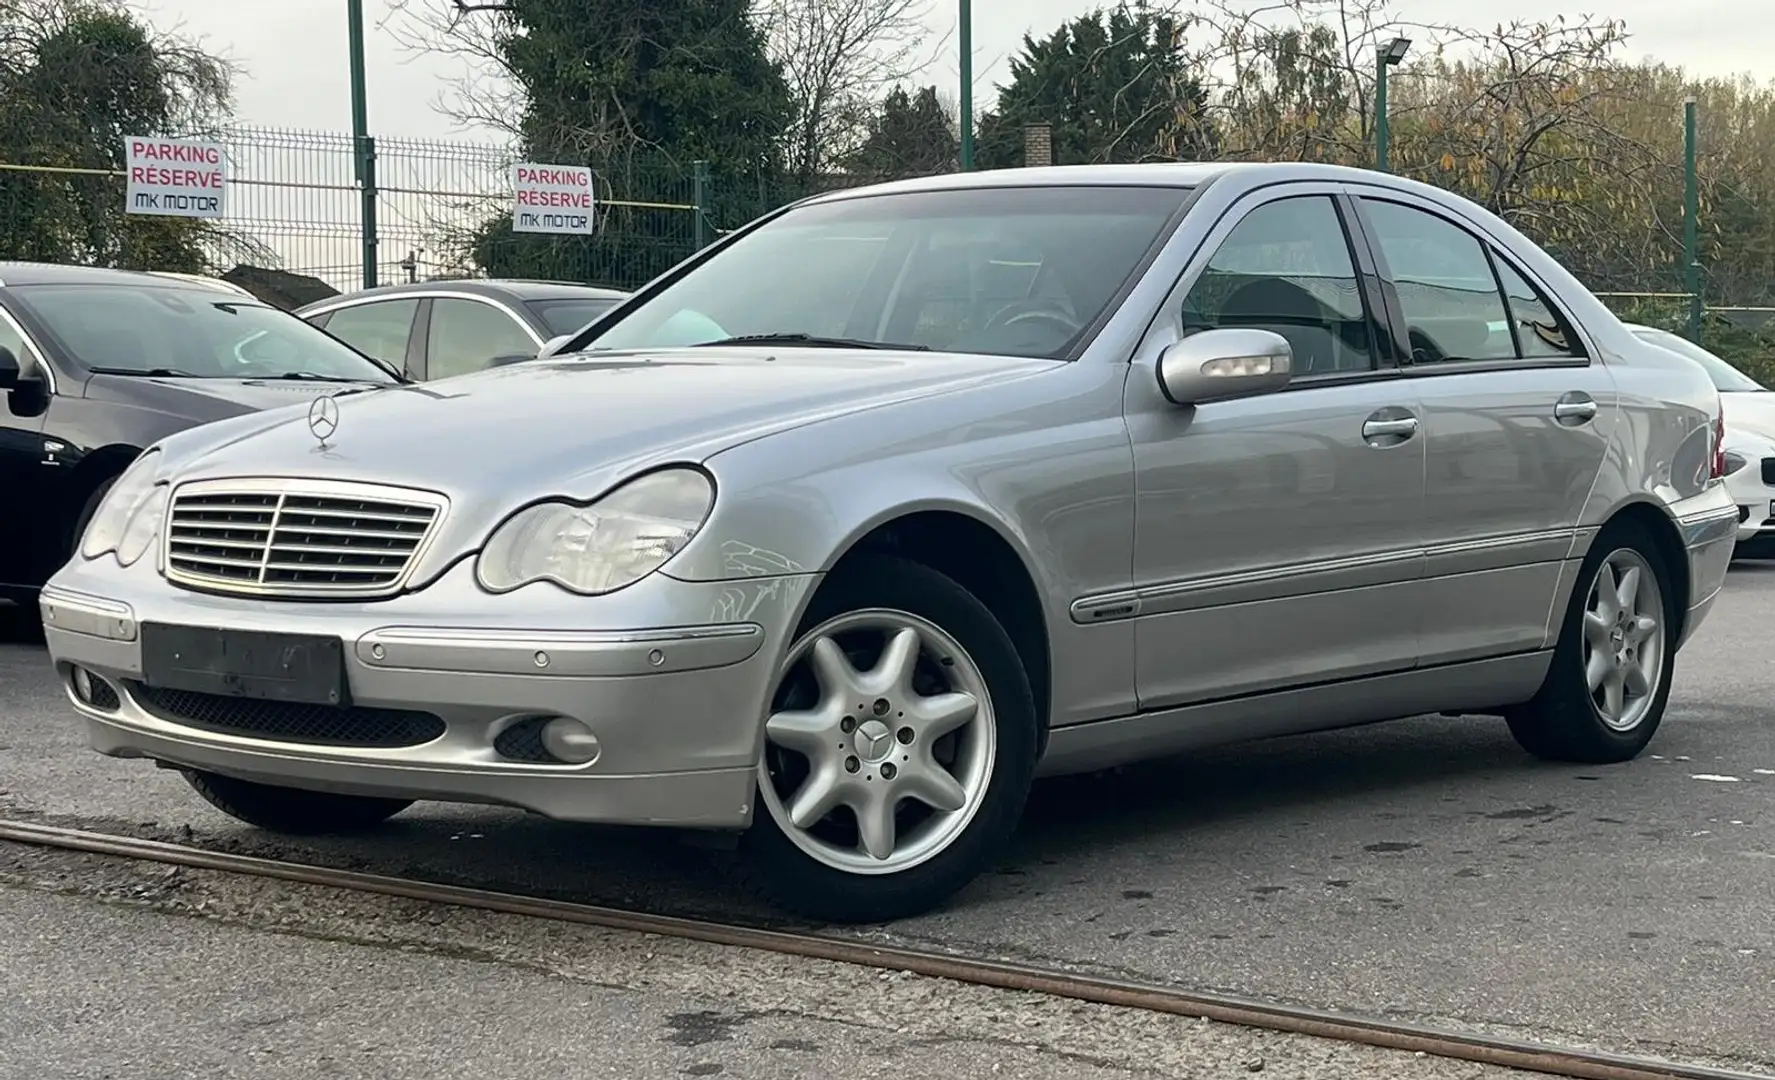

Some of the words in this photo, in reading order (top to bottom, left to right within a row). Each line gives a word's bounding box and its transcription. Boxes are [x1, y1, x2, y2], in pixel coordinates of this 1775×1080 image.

[133, 142, 219, 164] PARKING
[132, 164, 222, 188] RÉSERVÉ
[517, 168, 588, 186] PARKING
[135, 193, 159, 208] MK
[163, 195, 218, 212] MOTOR
[517, 187, 591, 208] RÉSERVÉ
[520, 213, 540, 227] MK
[543, 214, 588, 229] MOTOR
